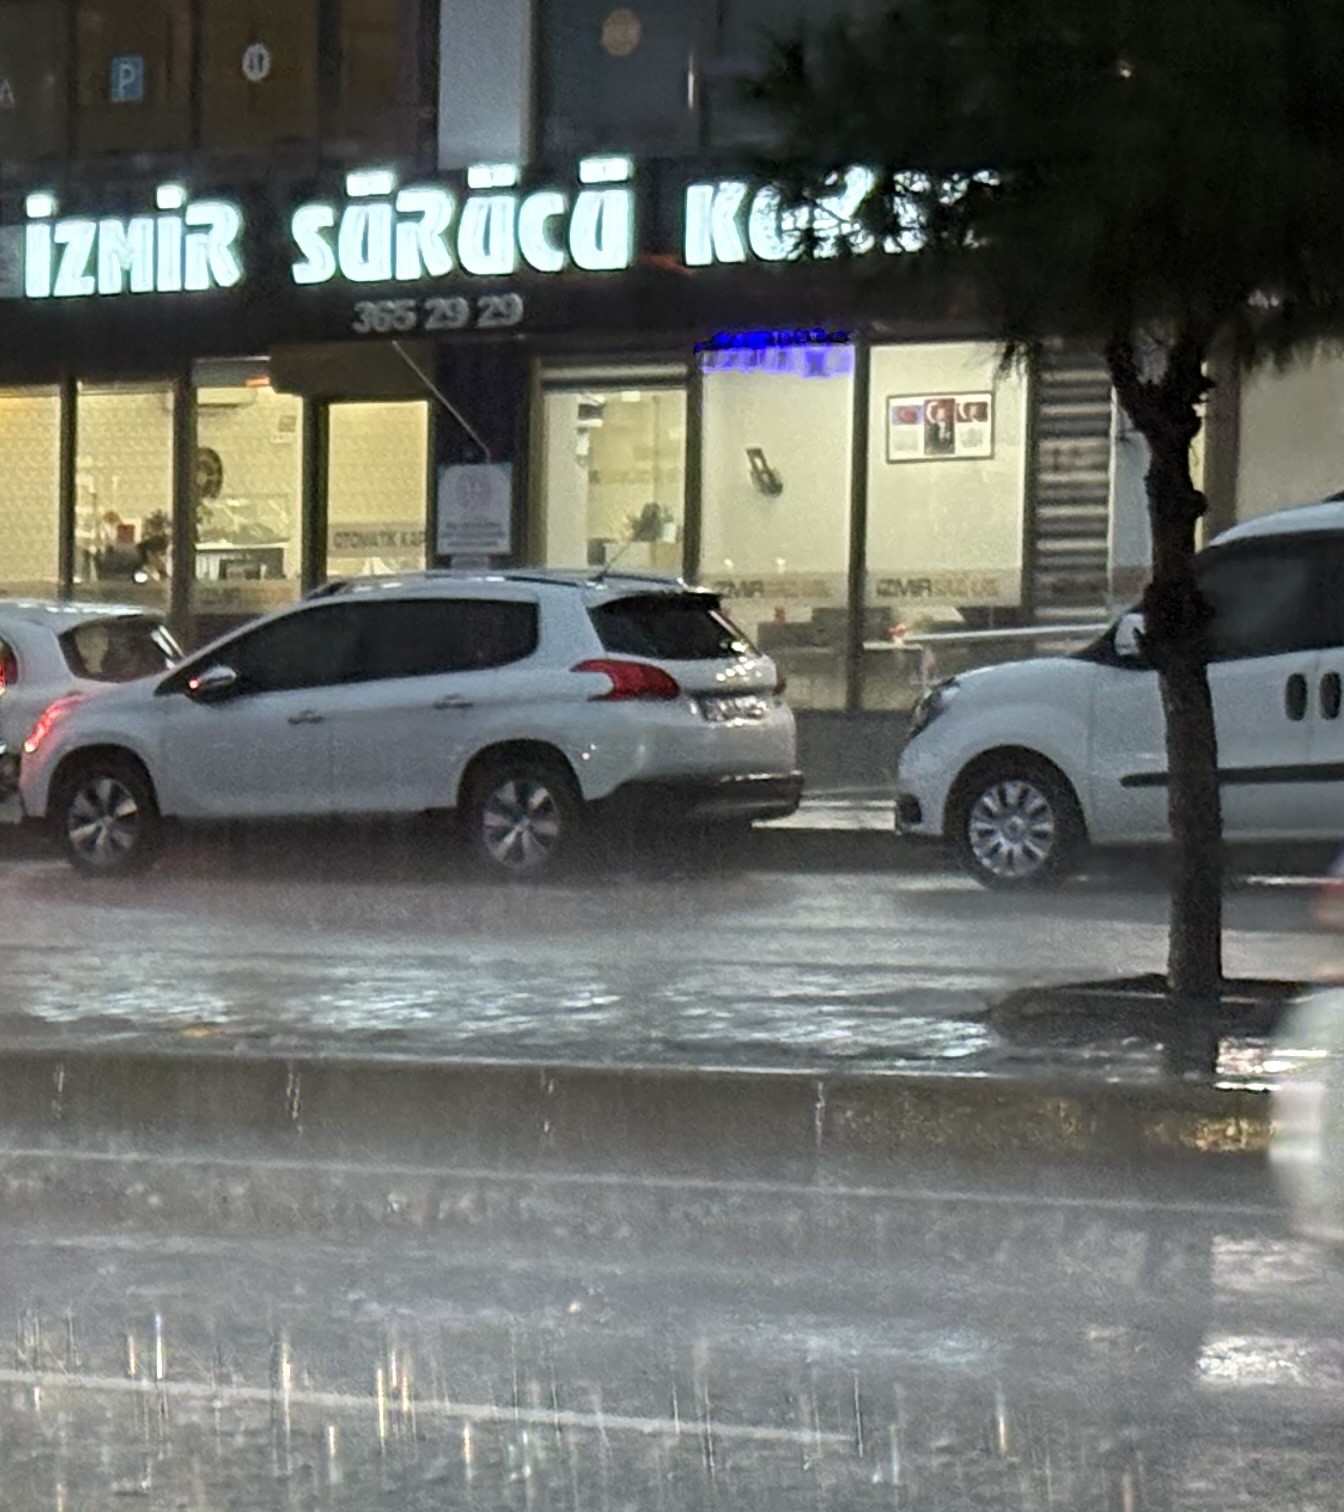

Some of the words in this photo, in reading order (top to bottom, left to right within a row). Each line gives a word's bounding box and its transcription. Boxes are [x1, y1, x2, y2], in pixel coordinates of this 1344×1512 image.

[25, 185, 242, 298] İZMİR
[291, 157, 630, 284] SÜRÜCÜ
[353, 300, 416, 334] 365
[424, 297, 470, 330] 29
[477, 293, 524, 328] 29
